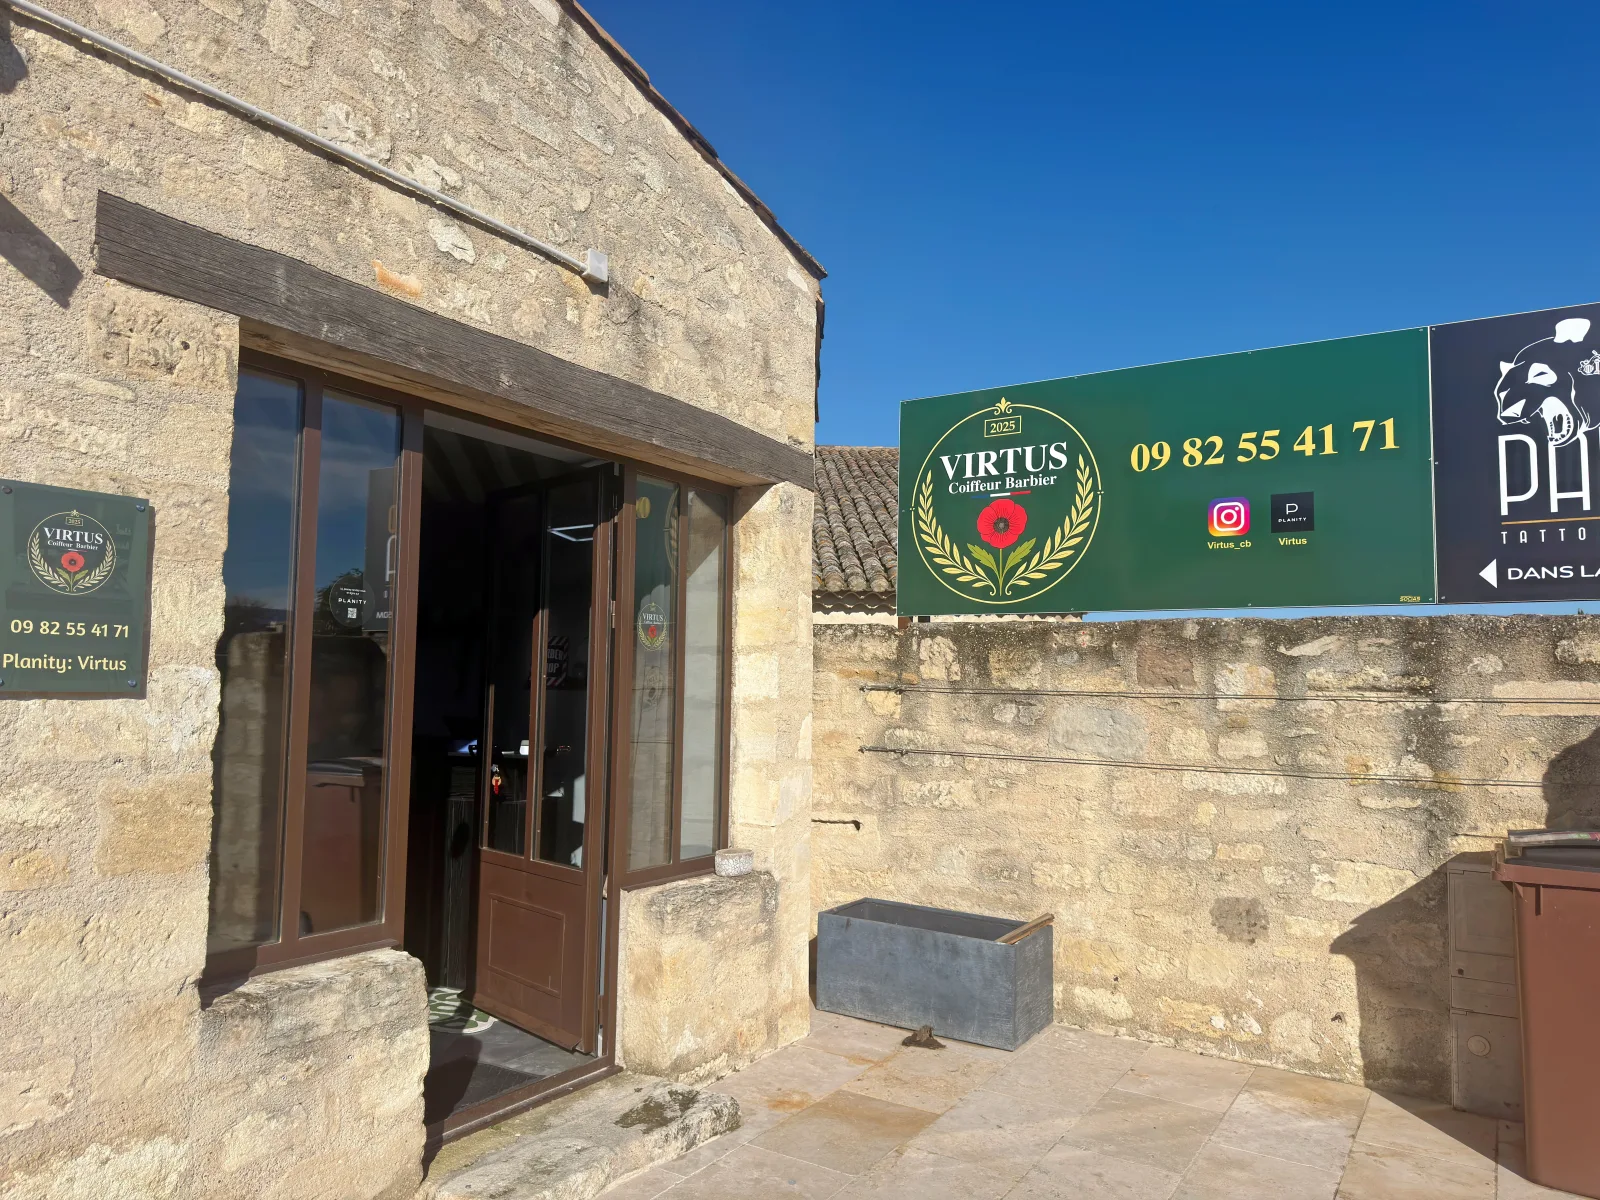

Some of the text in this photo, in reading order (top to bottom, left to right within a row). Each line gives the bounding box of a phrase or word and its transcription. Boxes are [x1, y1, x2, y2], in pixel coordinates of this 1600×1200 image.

[990, 420, 1016, 433] 2025
[1130, 417, 1400, 472] 09 82 55 41 71
[939, 441, 1068, 480] VIRTUS
[948, 474, 1057, 494] Coiffeur Barbier
[43, 526, 104, 545] VIRTUS
[1278, 537, 1308, 546] Virtus
[47, 540, 99, 551] Coiffeur Barbier
[1207, 539, 1252, 550] Virtus_cb
[1507, 565, 1574, 580] DANS
[337, 597, 367, 605] PLANITY
[642, 612, 664, 622] VIRTUS
[10, 619, 129, 638] 09 82 55 41 71
[2, 653, 127, 674] Planity: Virtus
